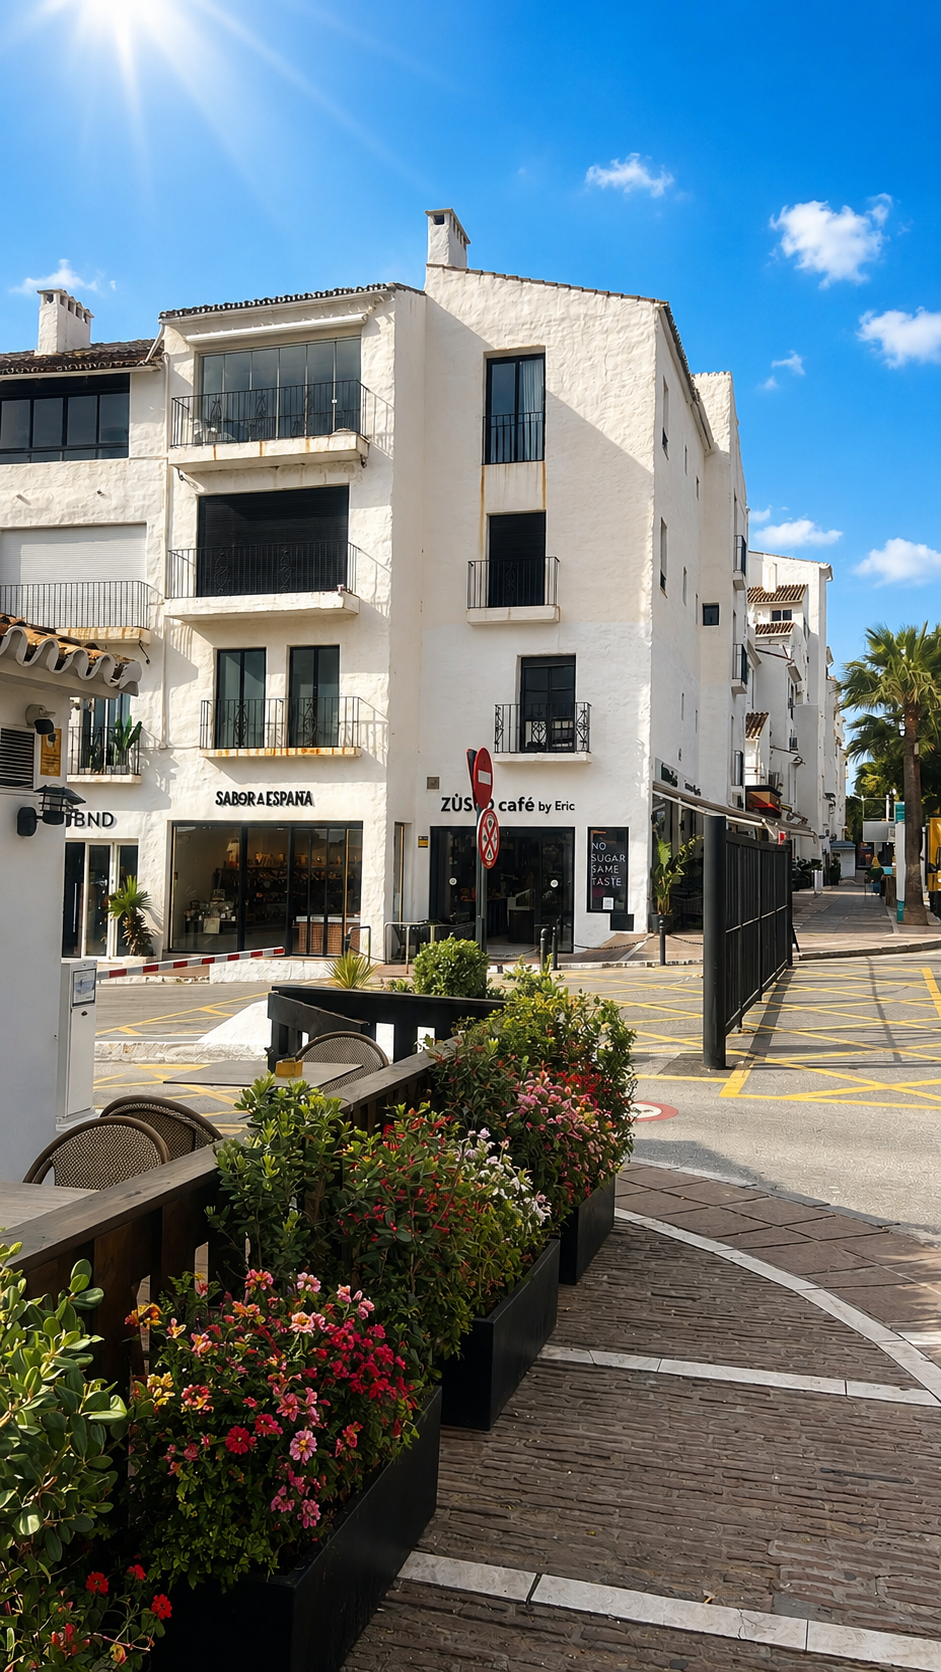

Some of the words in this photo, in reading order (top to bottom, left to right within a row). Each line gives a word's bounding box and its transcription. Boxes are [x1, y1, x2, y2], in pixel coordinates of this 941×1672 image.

[498, 796, 535, 812] café
[538, 801, 552, 814] by
[555, 801, 575, 811] Eric
[591, 842, 606, 850] NO
[591, 854, 626, 862] SUGAR
[591, 865, 619, 873] SAME
[591, 877, 622, 887] TASTE
